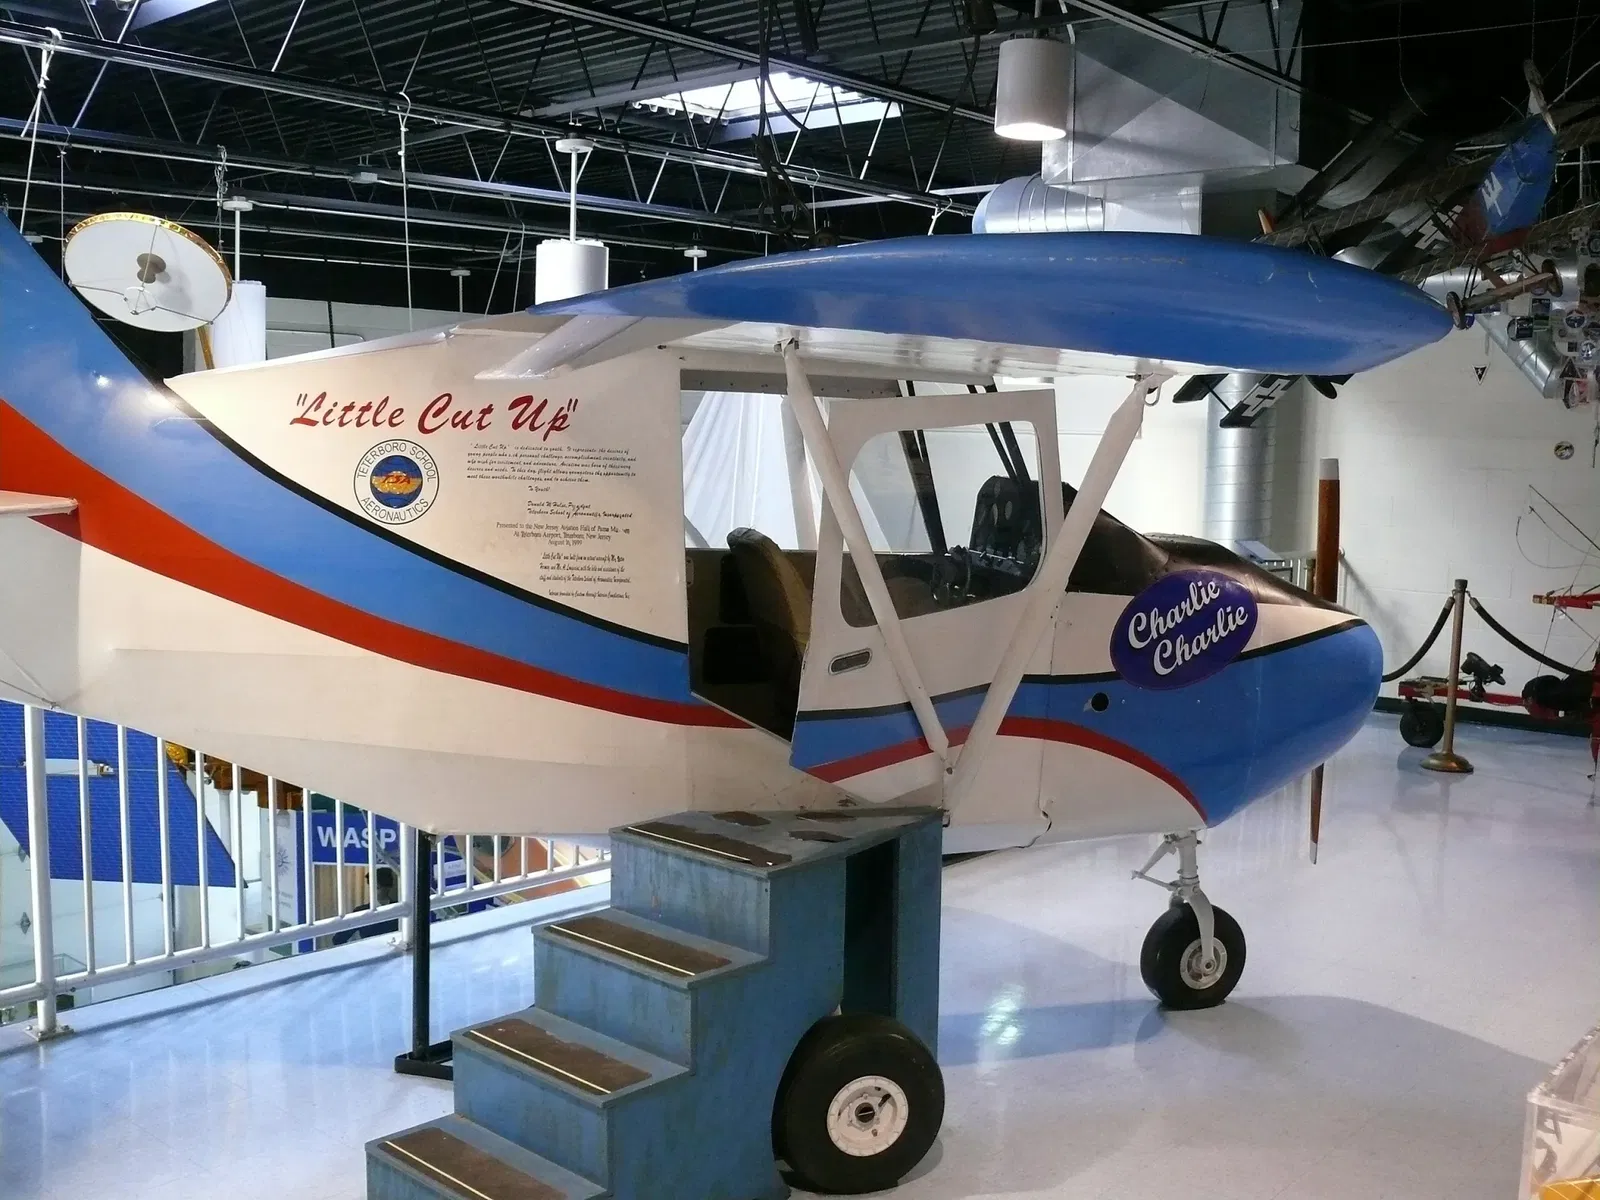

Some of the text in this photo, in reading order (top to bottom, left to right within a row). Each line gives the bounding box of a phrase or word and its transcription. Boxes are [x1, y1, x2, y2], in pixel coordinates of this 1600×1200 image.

[290, 391, 578, 442] "Little Cut Up"
[357, 442, 436, 482] TETERBORO SCHOOL
[361, 498, 428, 522] AERONAUTICS
[1128, 580, 1220, 648] Charlie
[1154, 606, 1248, 676] Charlie
[317, 826, 396, 850] WASP
